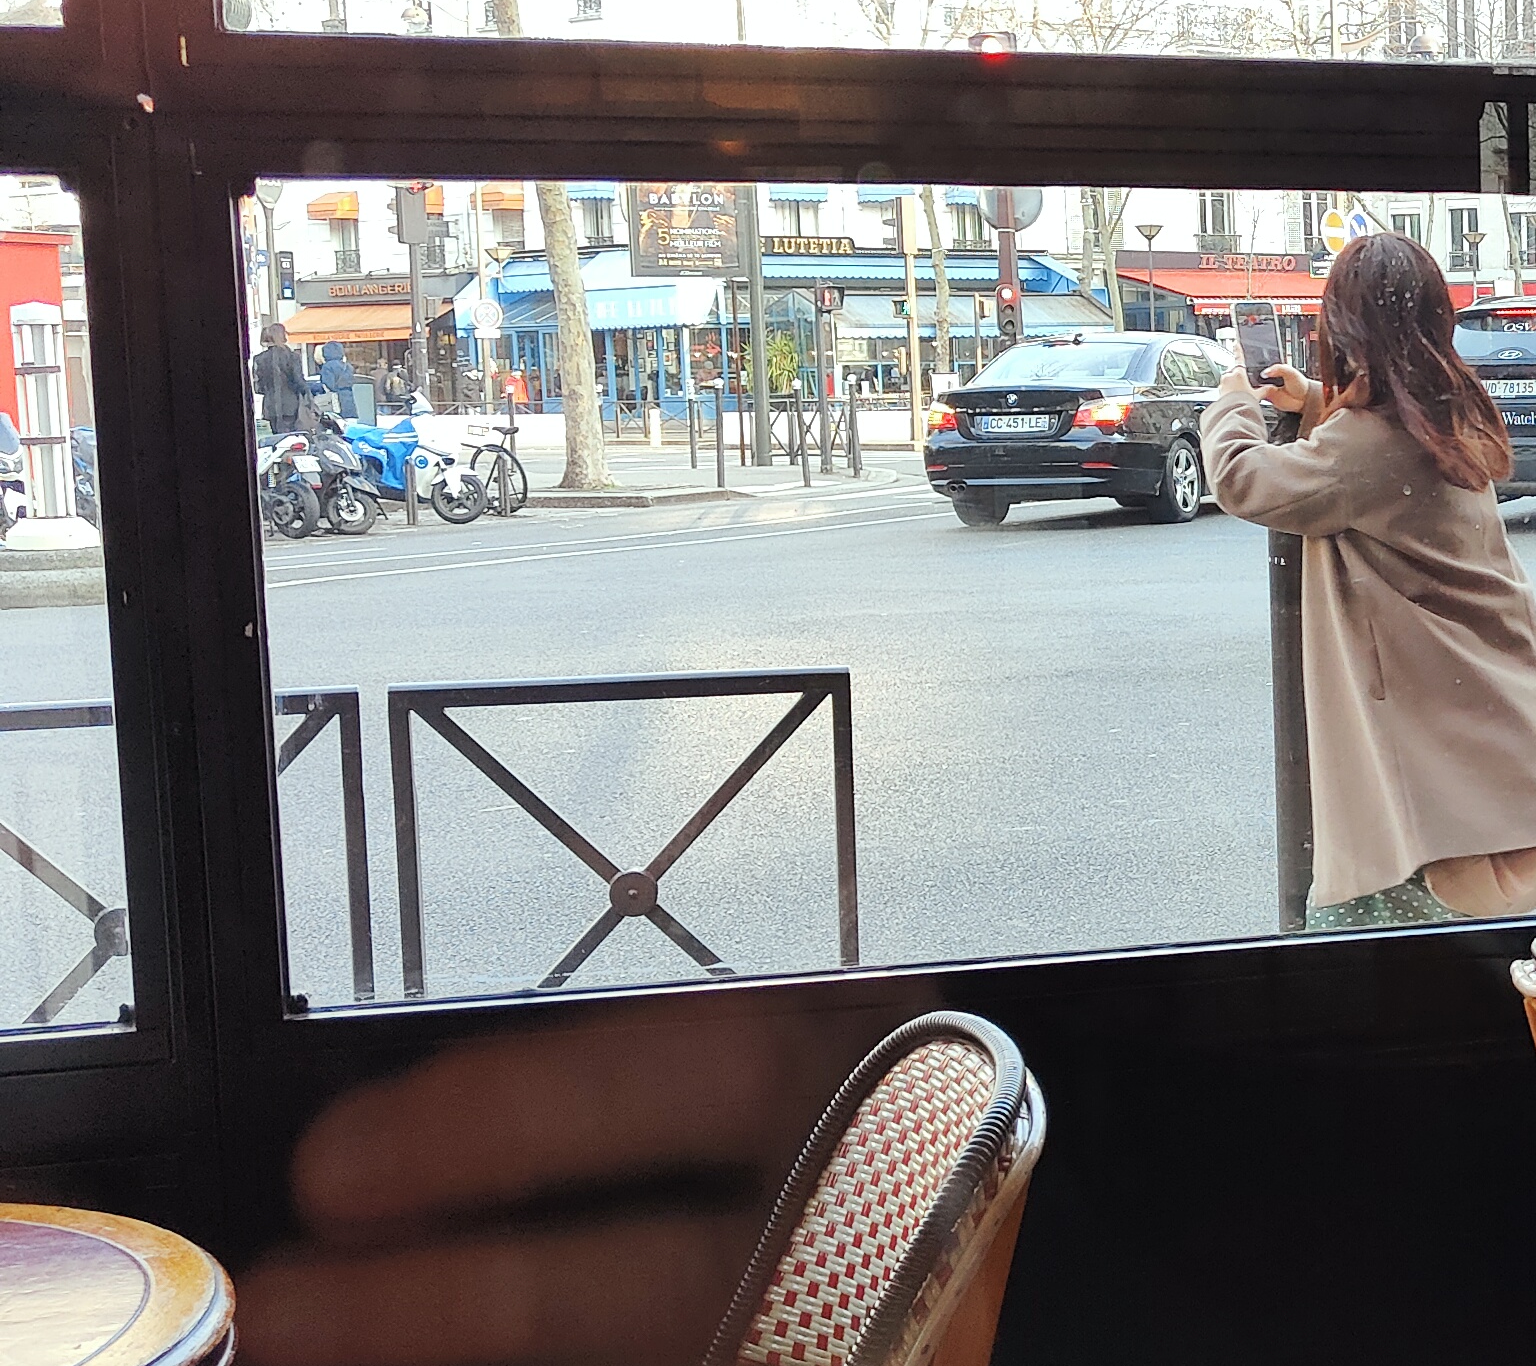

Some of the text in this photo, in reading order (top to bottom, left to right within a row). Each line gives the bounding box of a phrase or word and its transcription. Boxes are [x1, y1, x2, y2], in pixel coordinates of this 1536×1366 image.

[649, 193, 724, 205] BABYLON
[657, 228, 670, 245] 5
[772, 237, 853, 254] LUTETIA
[1199, 254, 1218, 269] IL
[1224, 254, 1297, 271] TEATRO
[1503, 382, 1534, 394] 78135
